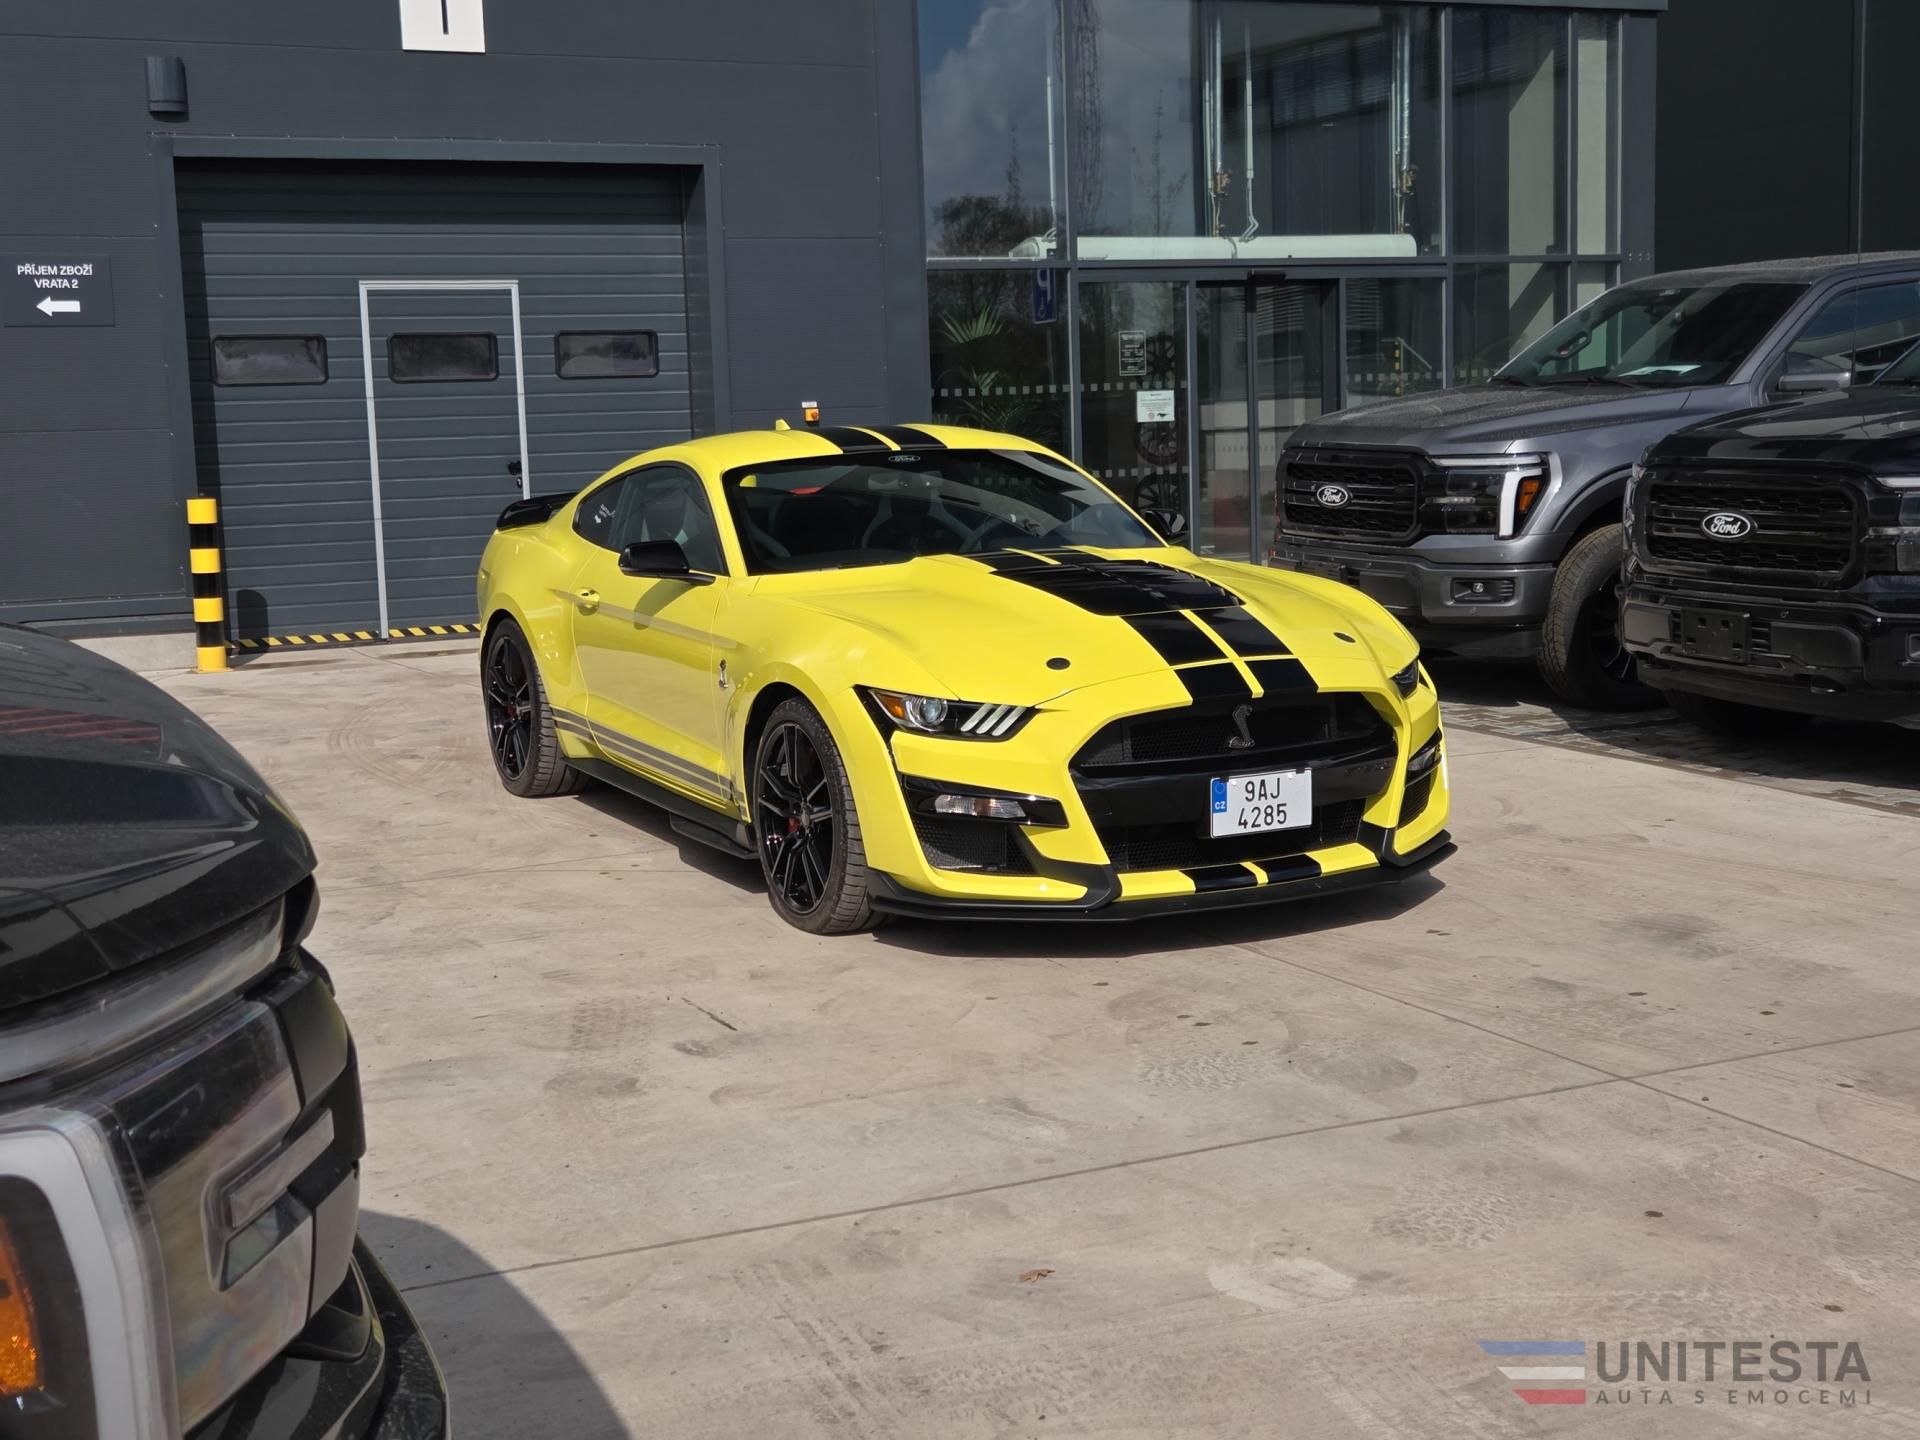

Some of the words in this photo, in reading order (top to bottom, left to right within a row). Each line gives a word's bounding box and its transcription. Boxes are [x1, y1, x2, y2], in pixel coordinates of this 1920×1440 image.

[17, 263, 58, 276] PŘÍJEM
[60, 263, 93, 276] ZBOŽÍ
[34, 278, 71, 289] VRATA
[71, 279, 79, 289] 2
[1322, 488, 1345, 503] Ford
[1710, 515, 1741, 534] Ford
[1244, 777, 1281, 802] 9AJ
[1214, 800, 1226, 810] CZ
[1237, 803, 1287, 829] 4285
